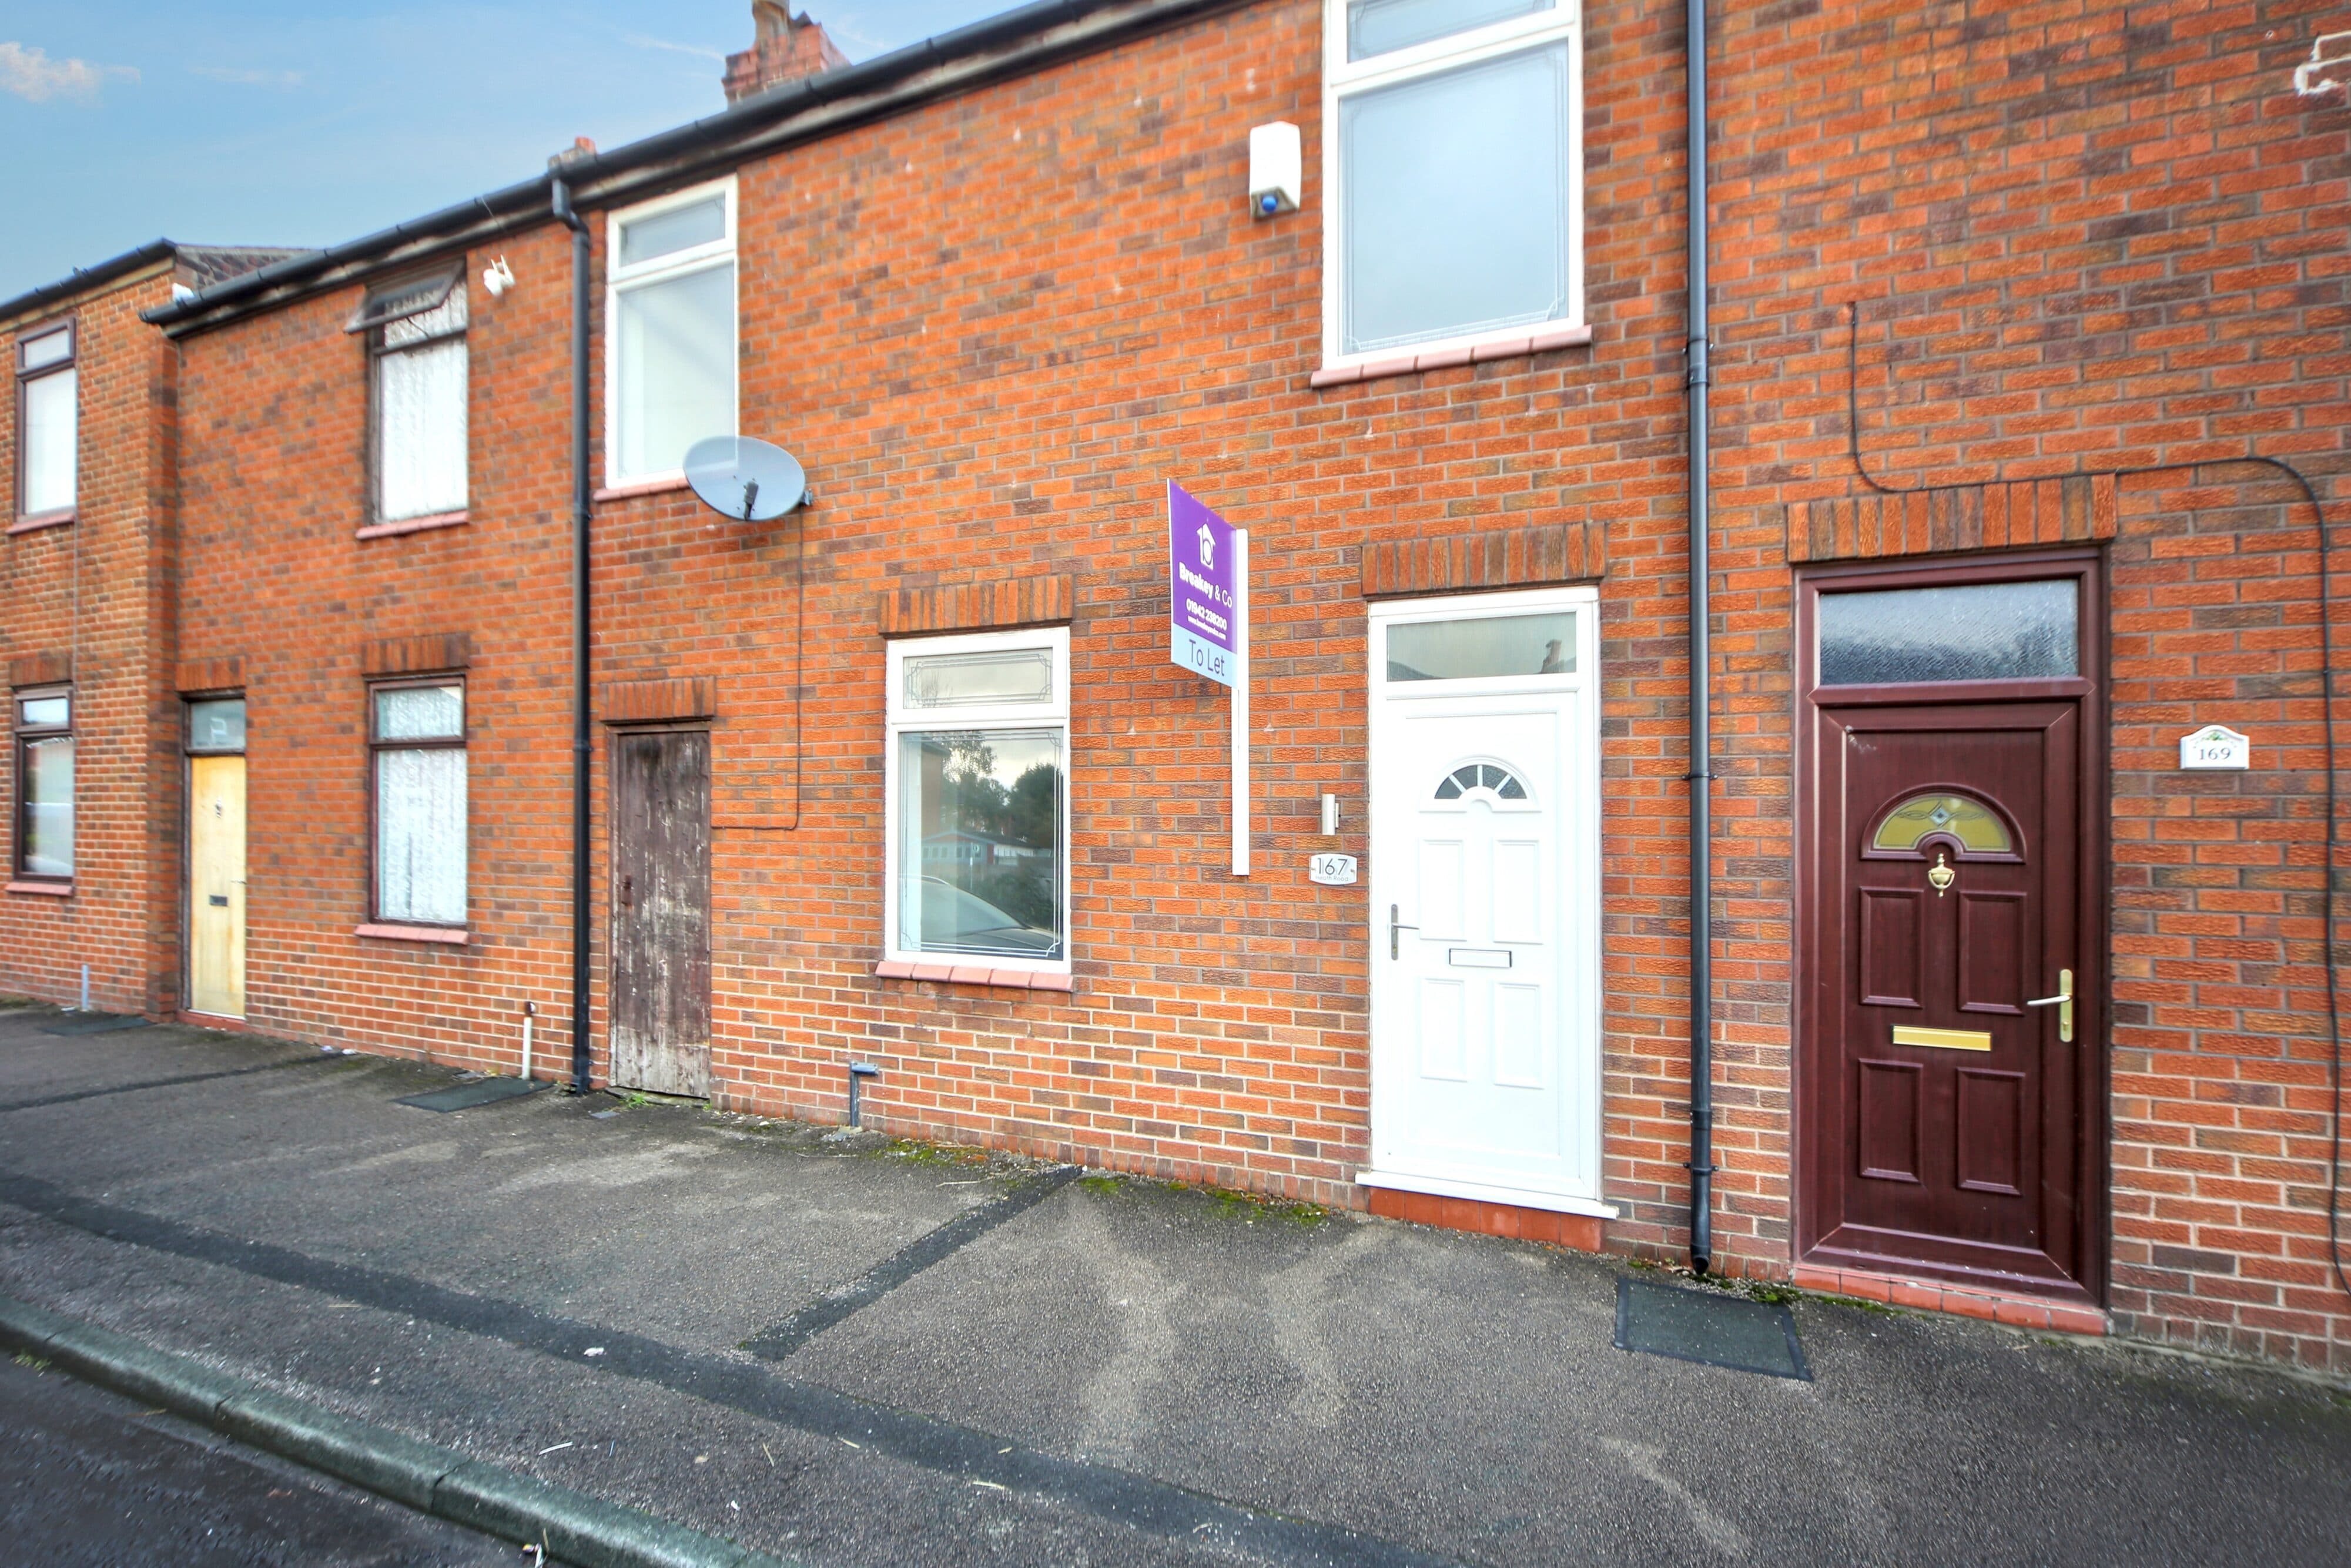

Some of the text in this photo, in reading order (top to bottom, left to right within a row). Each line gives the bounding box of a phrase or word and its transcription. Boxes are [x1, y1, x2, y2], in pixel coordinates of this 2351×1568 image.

[1179, 562, 1233, 608] Breakey & Co
[1189, 639, 1225, 676] To Let
[2199, 747, 2231, 760] 169
[1317, 857, 1348, 875] 167
